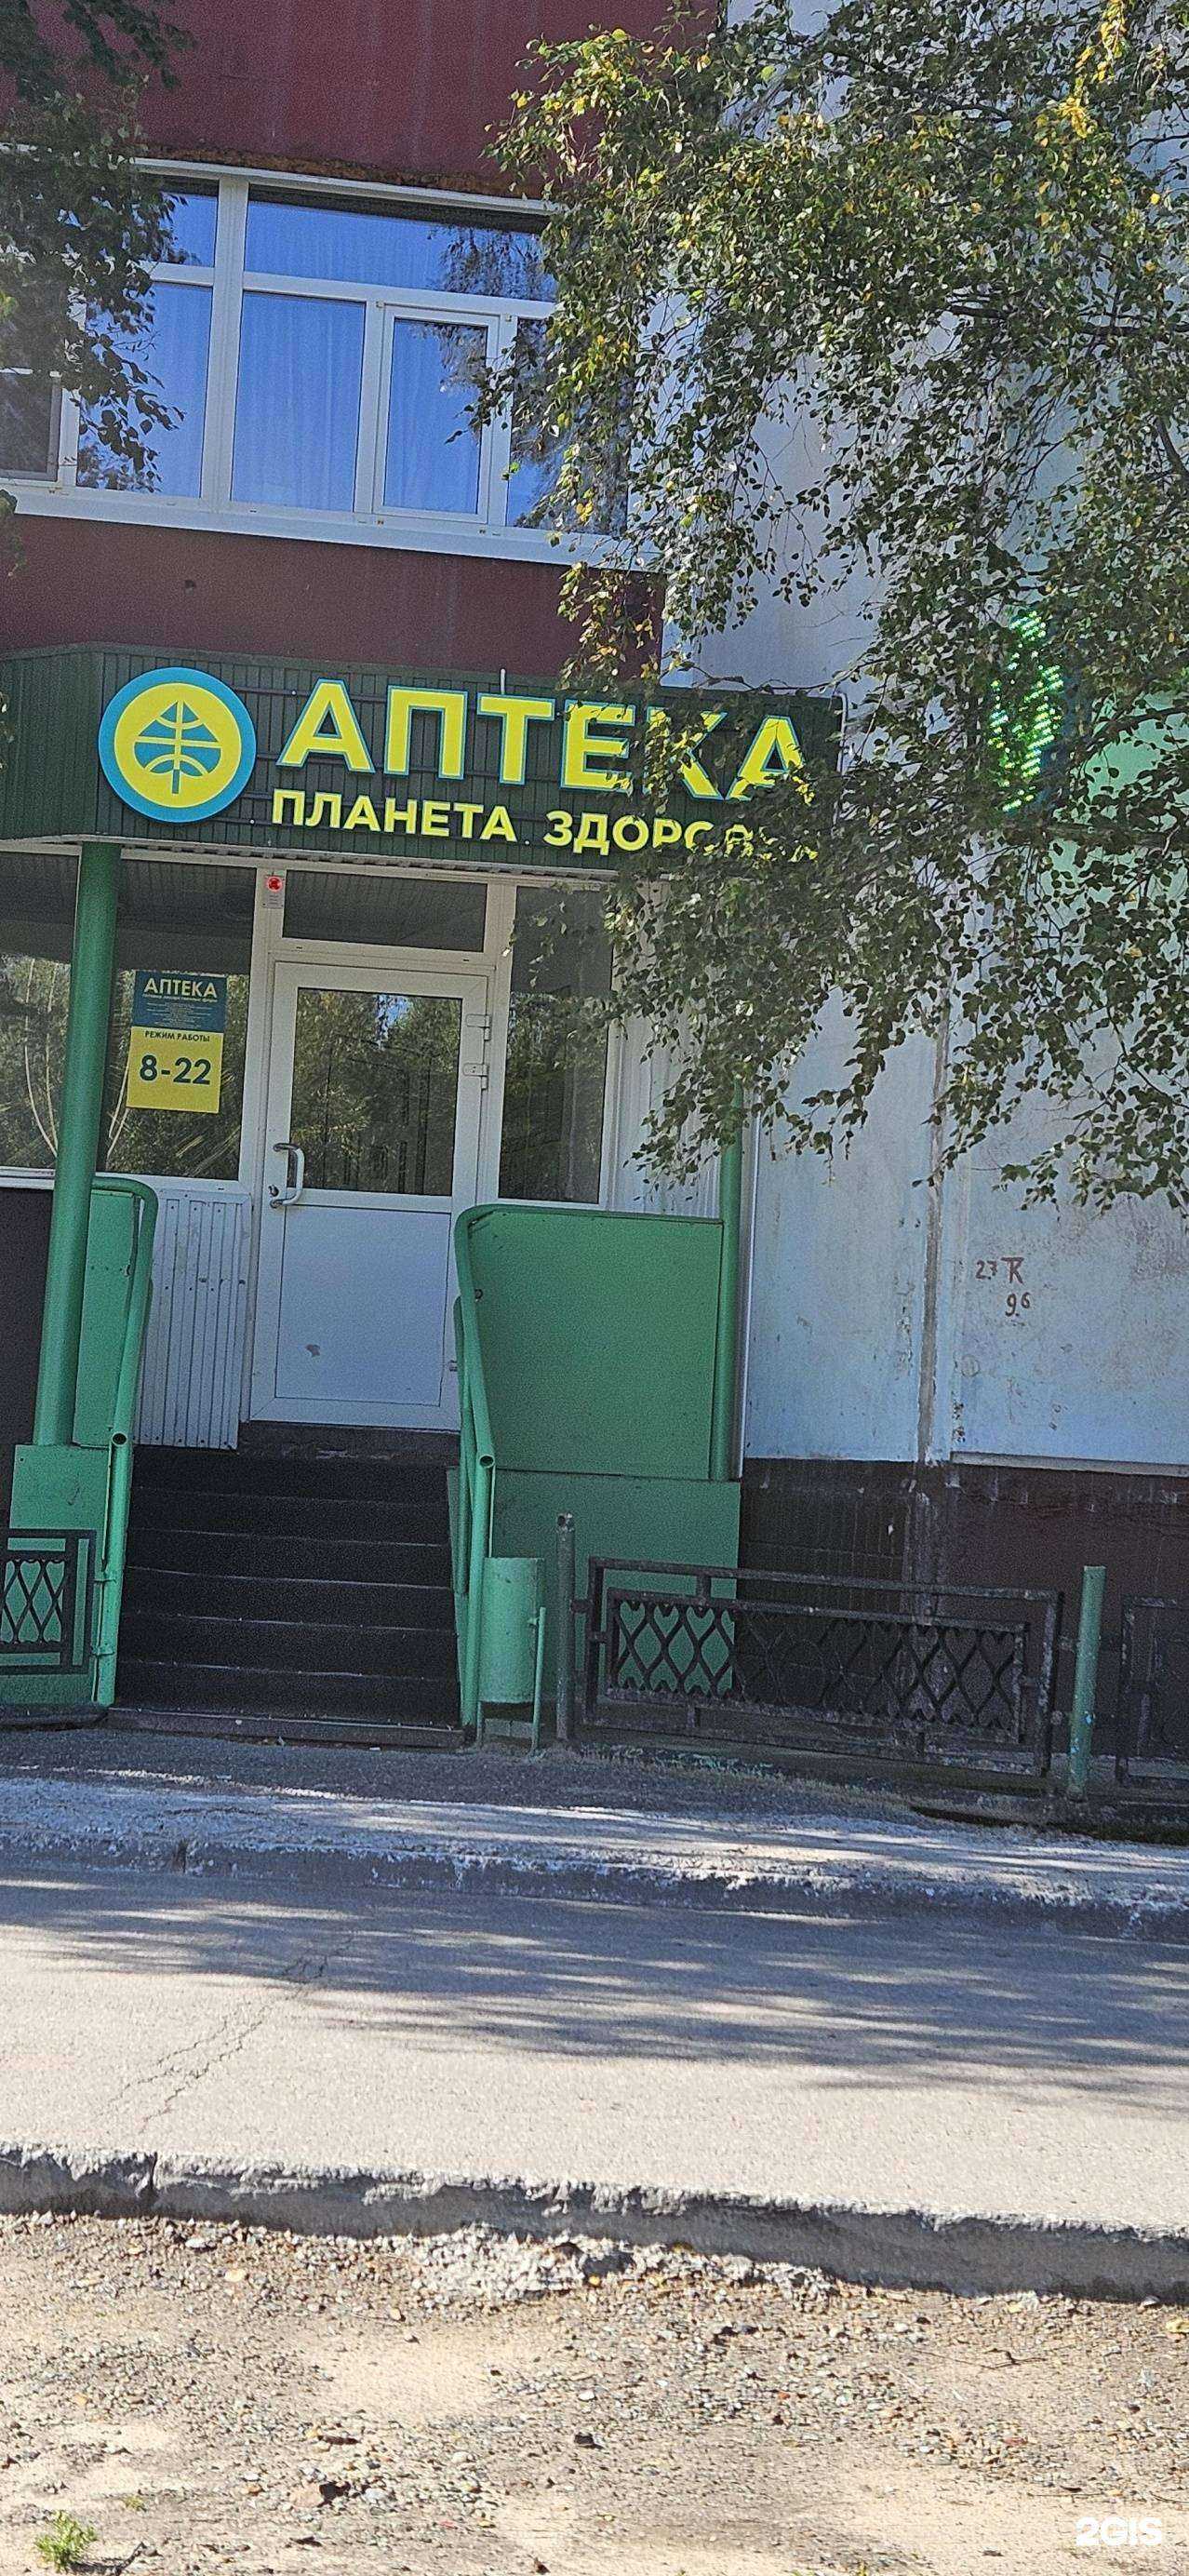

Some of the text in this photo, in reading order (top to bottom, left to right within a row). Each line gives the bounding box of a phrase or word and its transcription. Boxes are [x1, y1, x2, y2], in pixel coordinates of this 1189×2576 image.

[275, 678, 817, 806] АПТЕКА
[272, 788, 517, 842] ПЛАНЕТА
[143, 977, 218, 999] АПТЕКА
[144, 1029, 210, 1042] РЕЖИМ РАБОТЫ
[140, 1054, 211, 1085] 8-22
